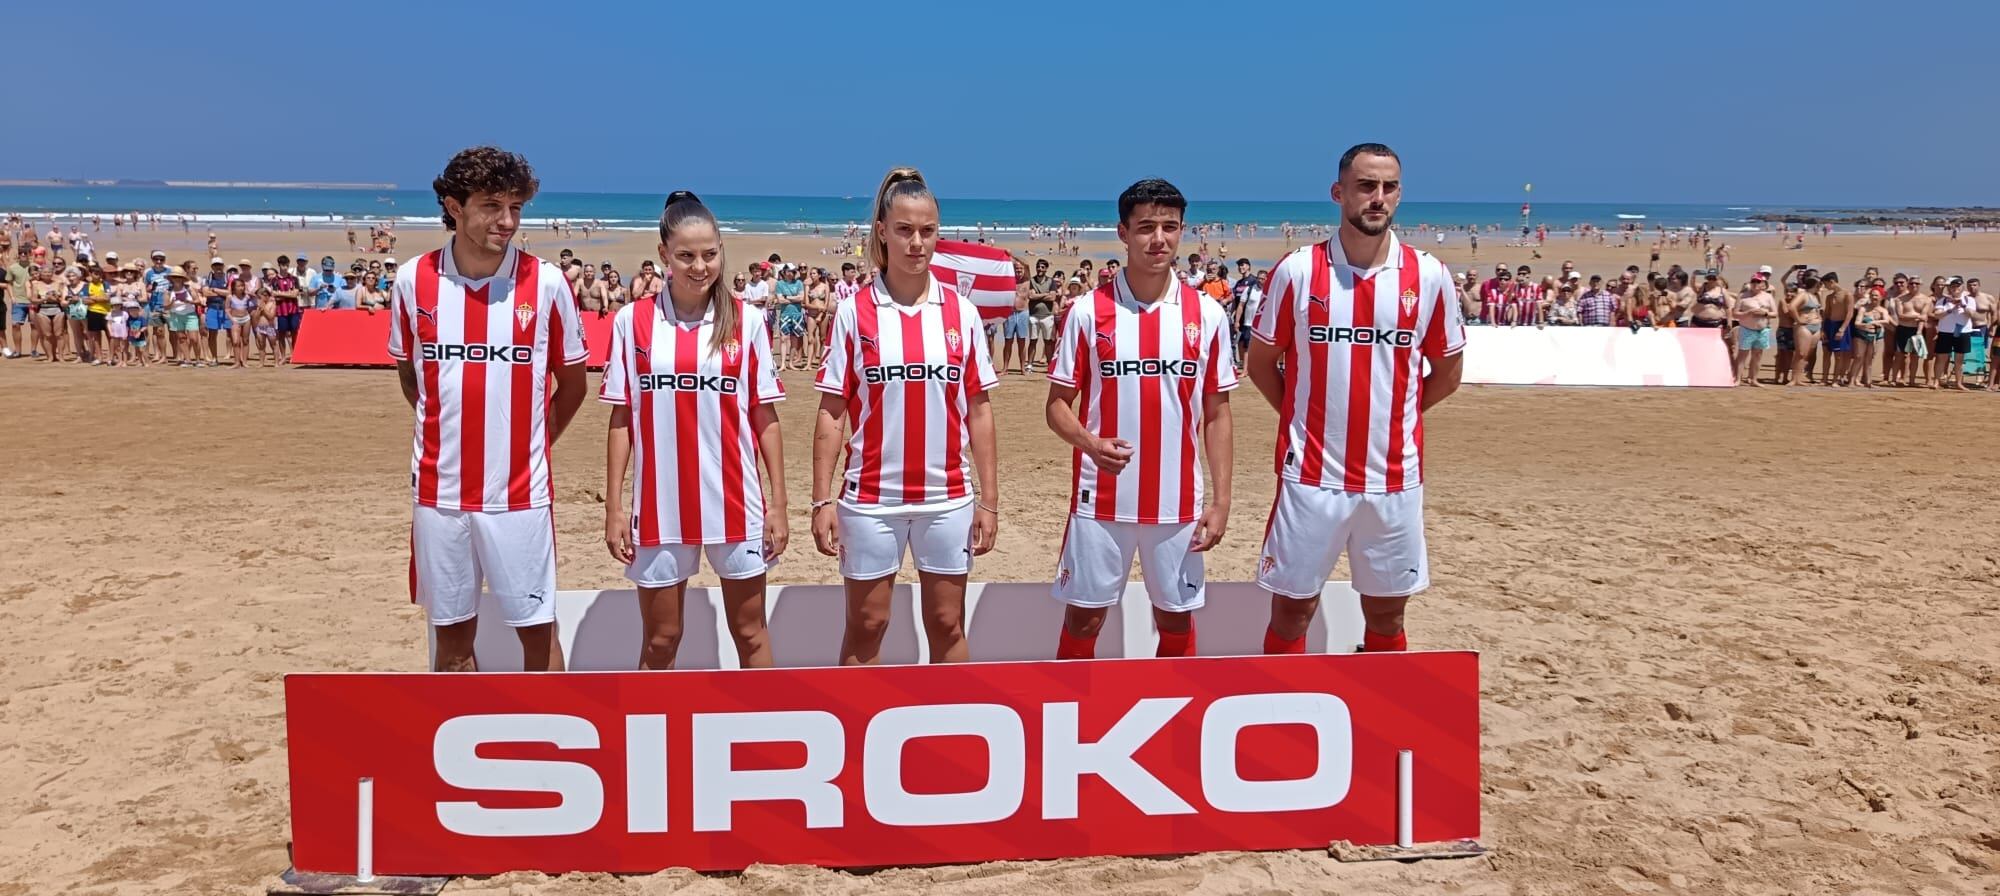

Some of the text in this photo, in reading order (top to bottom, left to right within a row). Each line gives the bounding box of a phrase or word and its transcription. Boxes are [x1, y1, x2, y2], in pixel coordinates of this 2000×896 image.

[1308, 325, 1414, 347] SIROKO
[421, 342, 533, 364] SIROKO
[863, 363, 962, 384] SIROKO
[1098, 358, 1199, 378] SIROKO
[638, 374, 738, 395] SIROKO
[433, 693, 1353, 837] SIROKO
